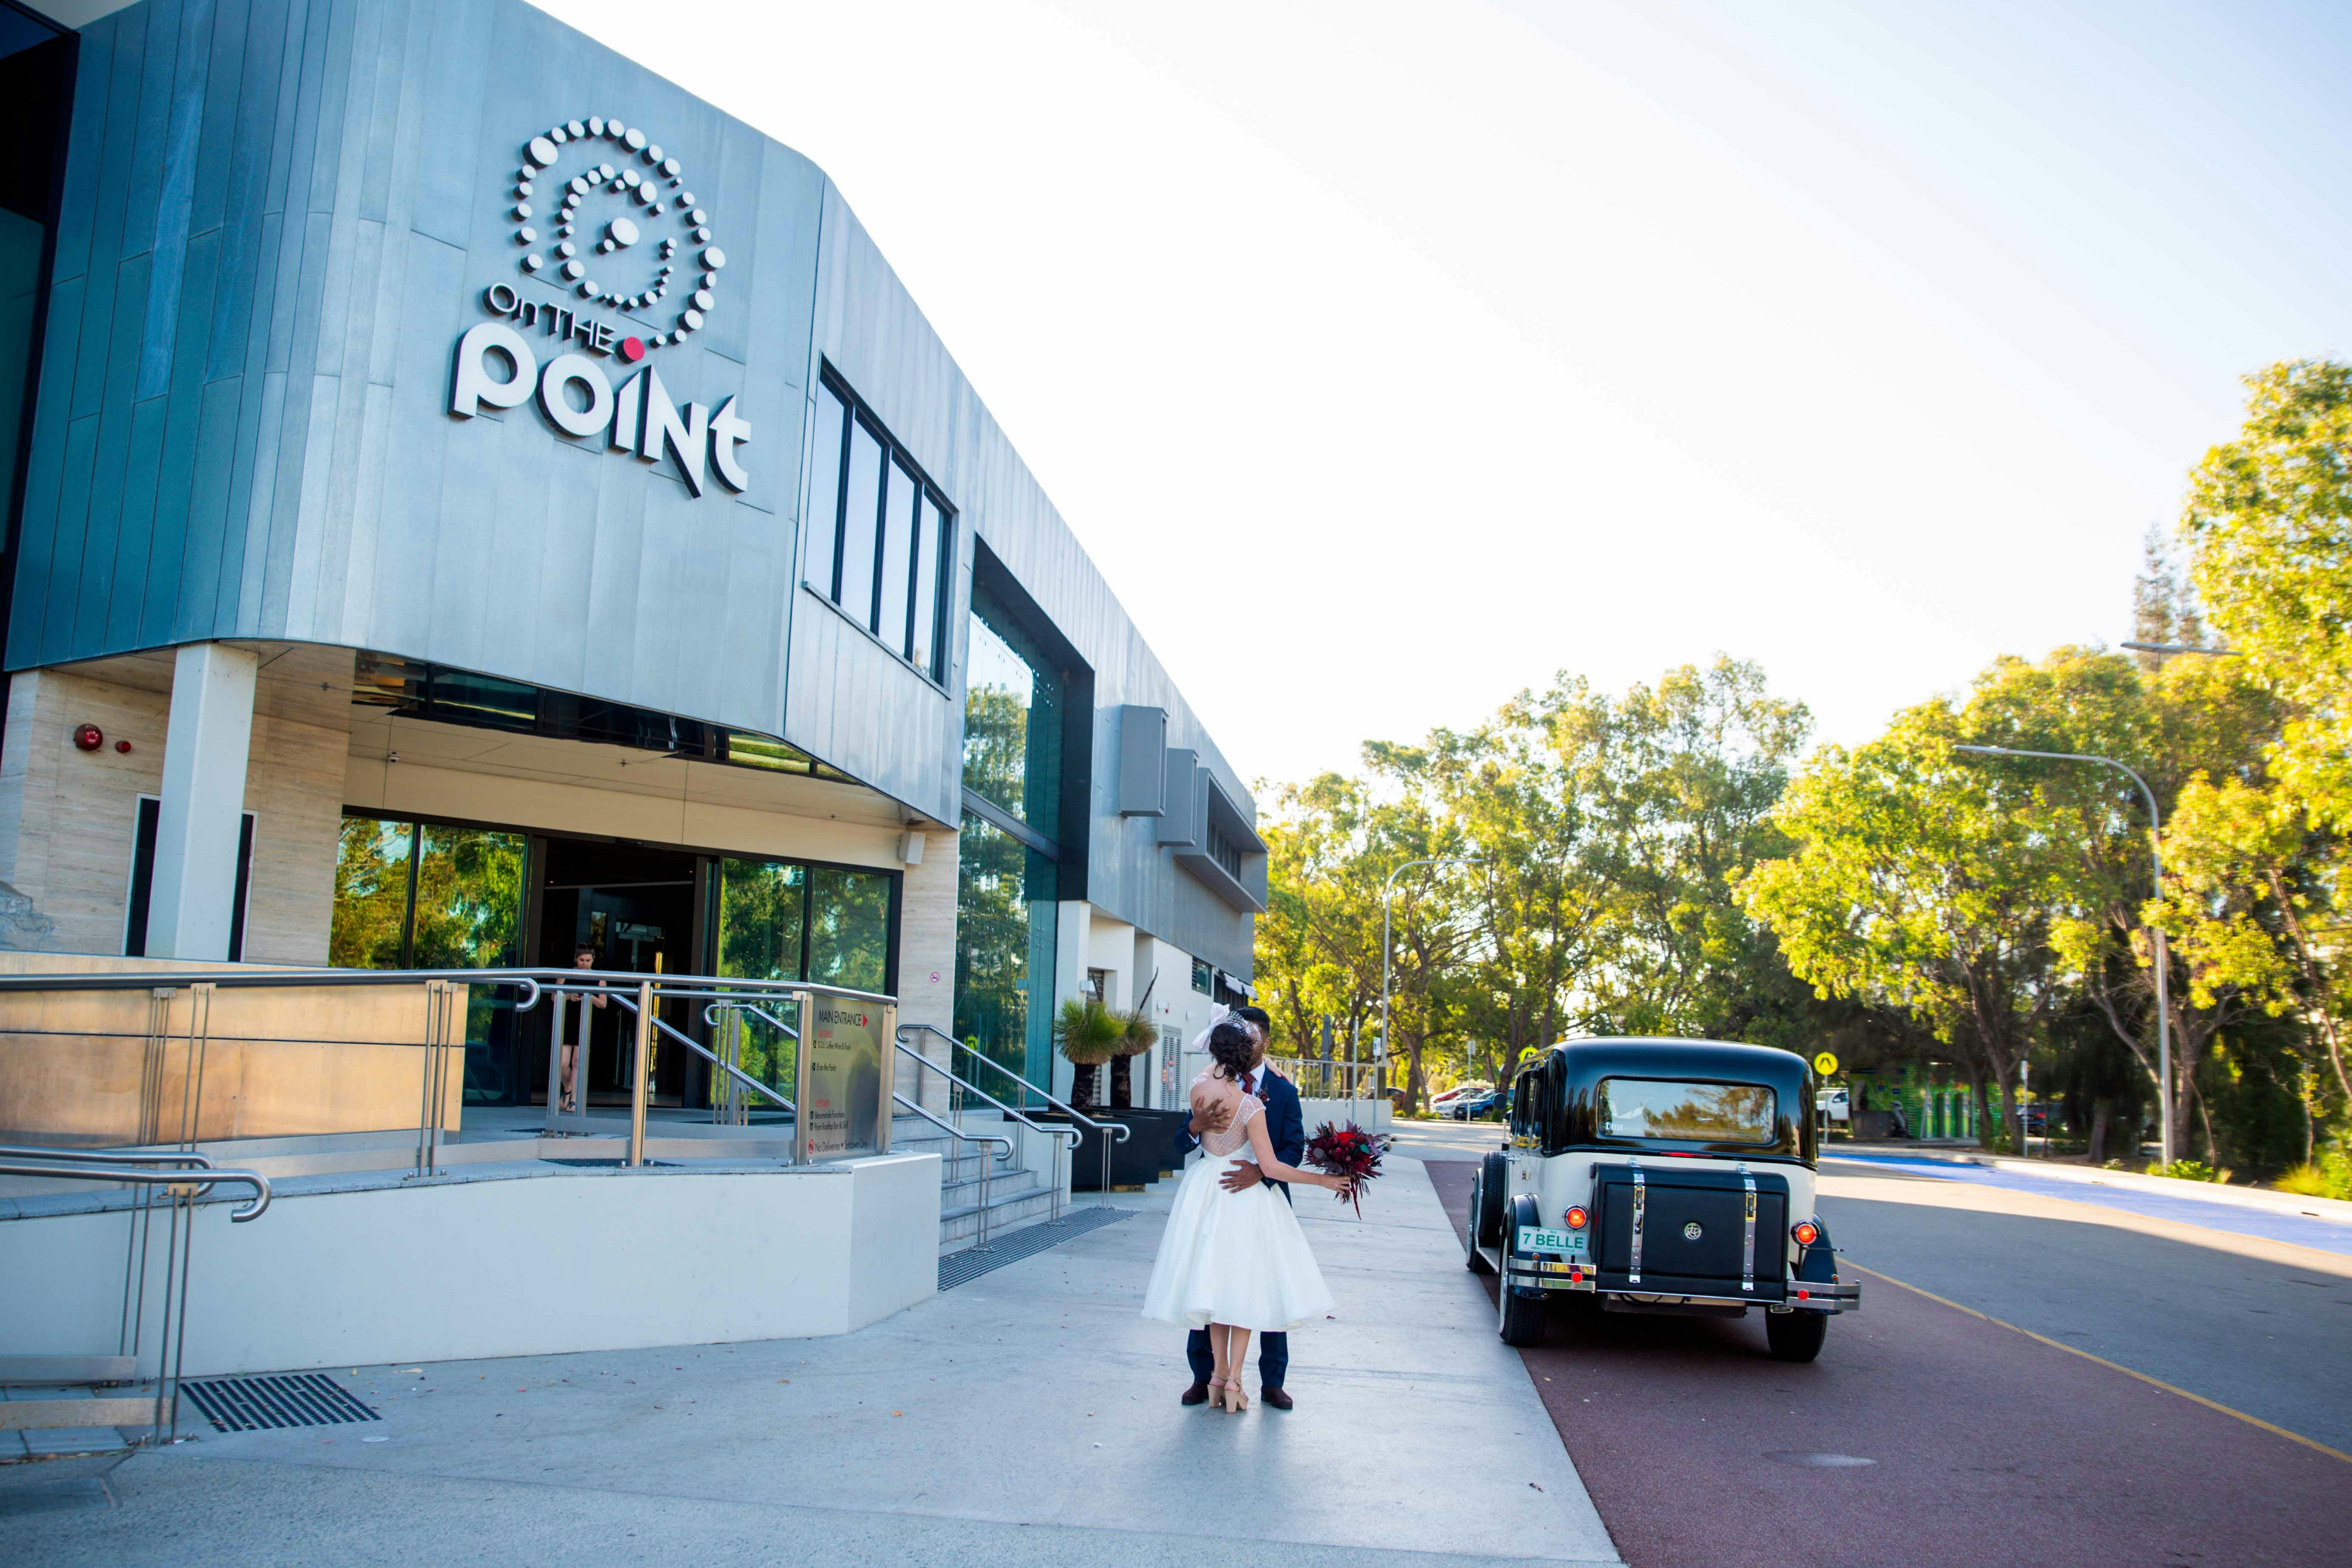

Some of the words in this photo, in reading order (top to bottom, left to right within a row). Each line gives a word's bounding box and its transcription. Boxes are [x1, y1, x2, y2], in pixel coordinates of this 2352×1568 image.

[541, 301, 615, 356] THE
[818, 1009, 833, 1023] MAIN
[834, 1011, 861, 1026] ENTRANCE
[815, 1141, 821, 1152] No
[823, 1140, 840, 1152] Deliveries
[860, 1137, 868, 1150] Only
[1523, 1233, 1531, 1244] 7
[1535, 1234, 1583, 1249] BELLE
